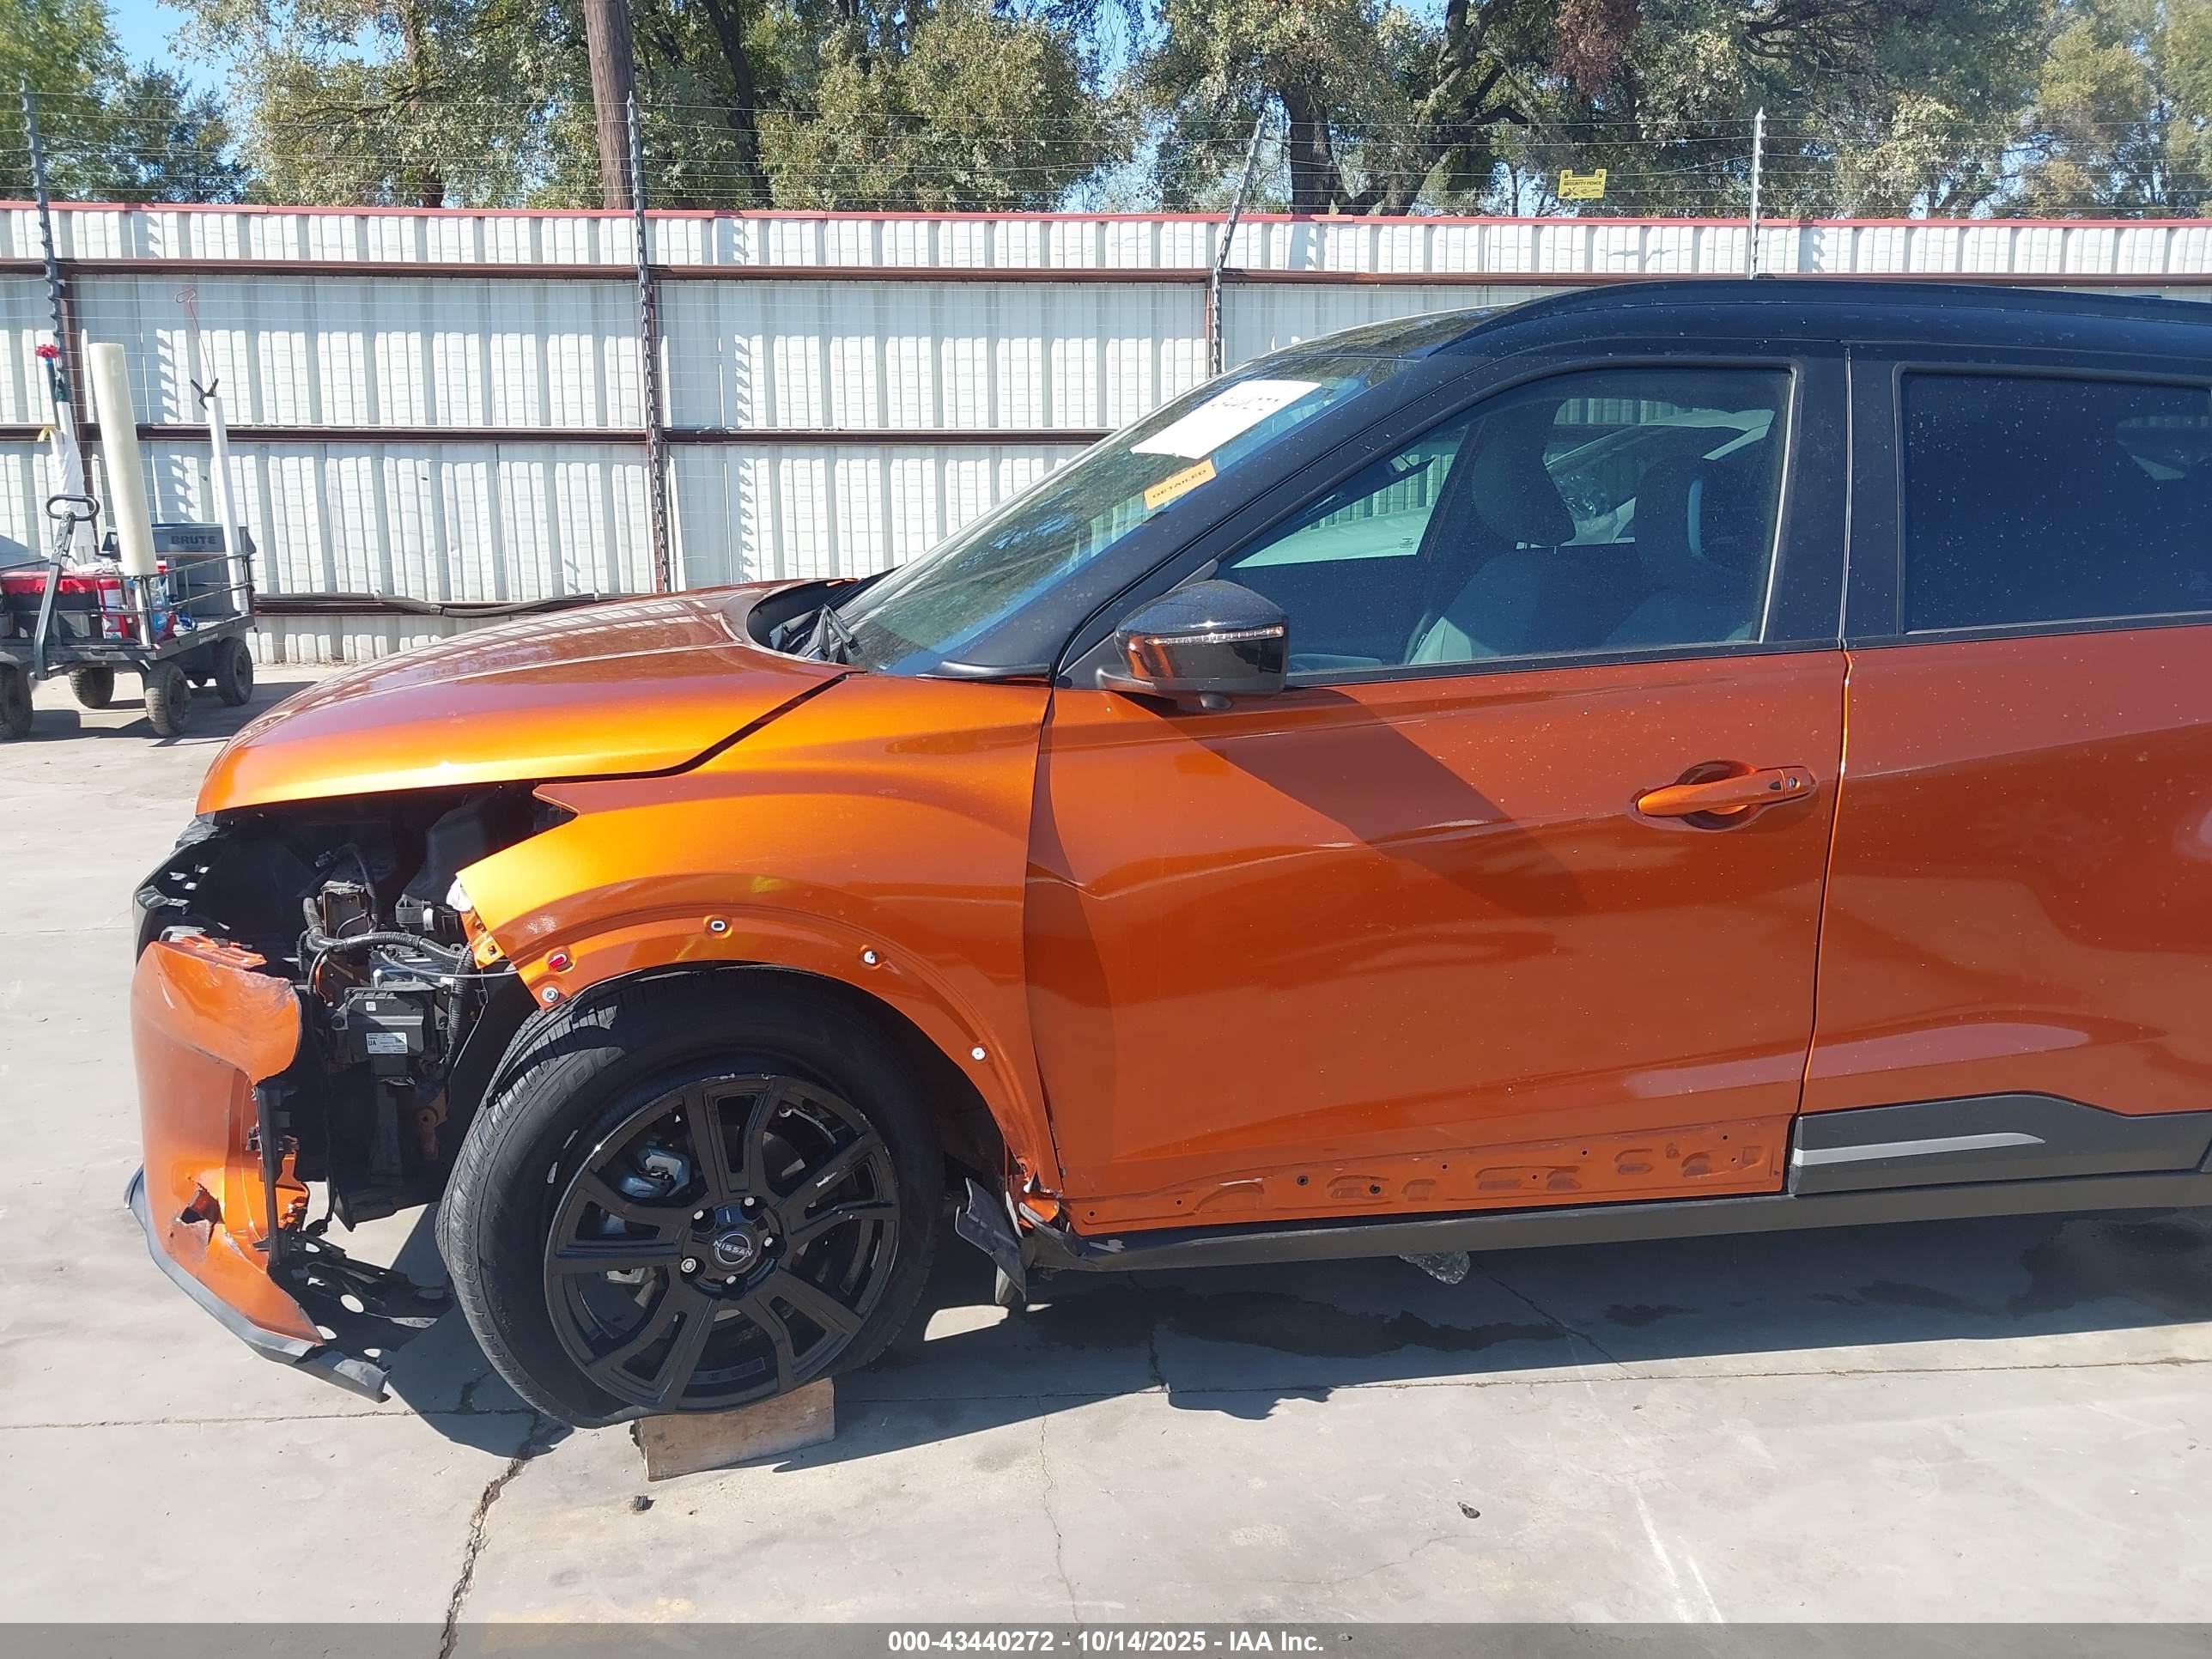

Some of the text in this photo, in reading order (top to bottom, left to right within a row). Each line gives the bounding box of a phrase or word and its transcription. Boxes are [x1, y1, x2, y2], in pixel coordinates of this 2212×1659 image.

[1152, 469, 1206, 499] DETAILED
[171, 535, 216, 545] BRUTE
[713, 1239, 754, 1257] NISSAN
